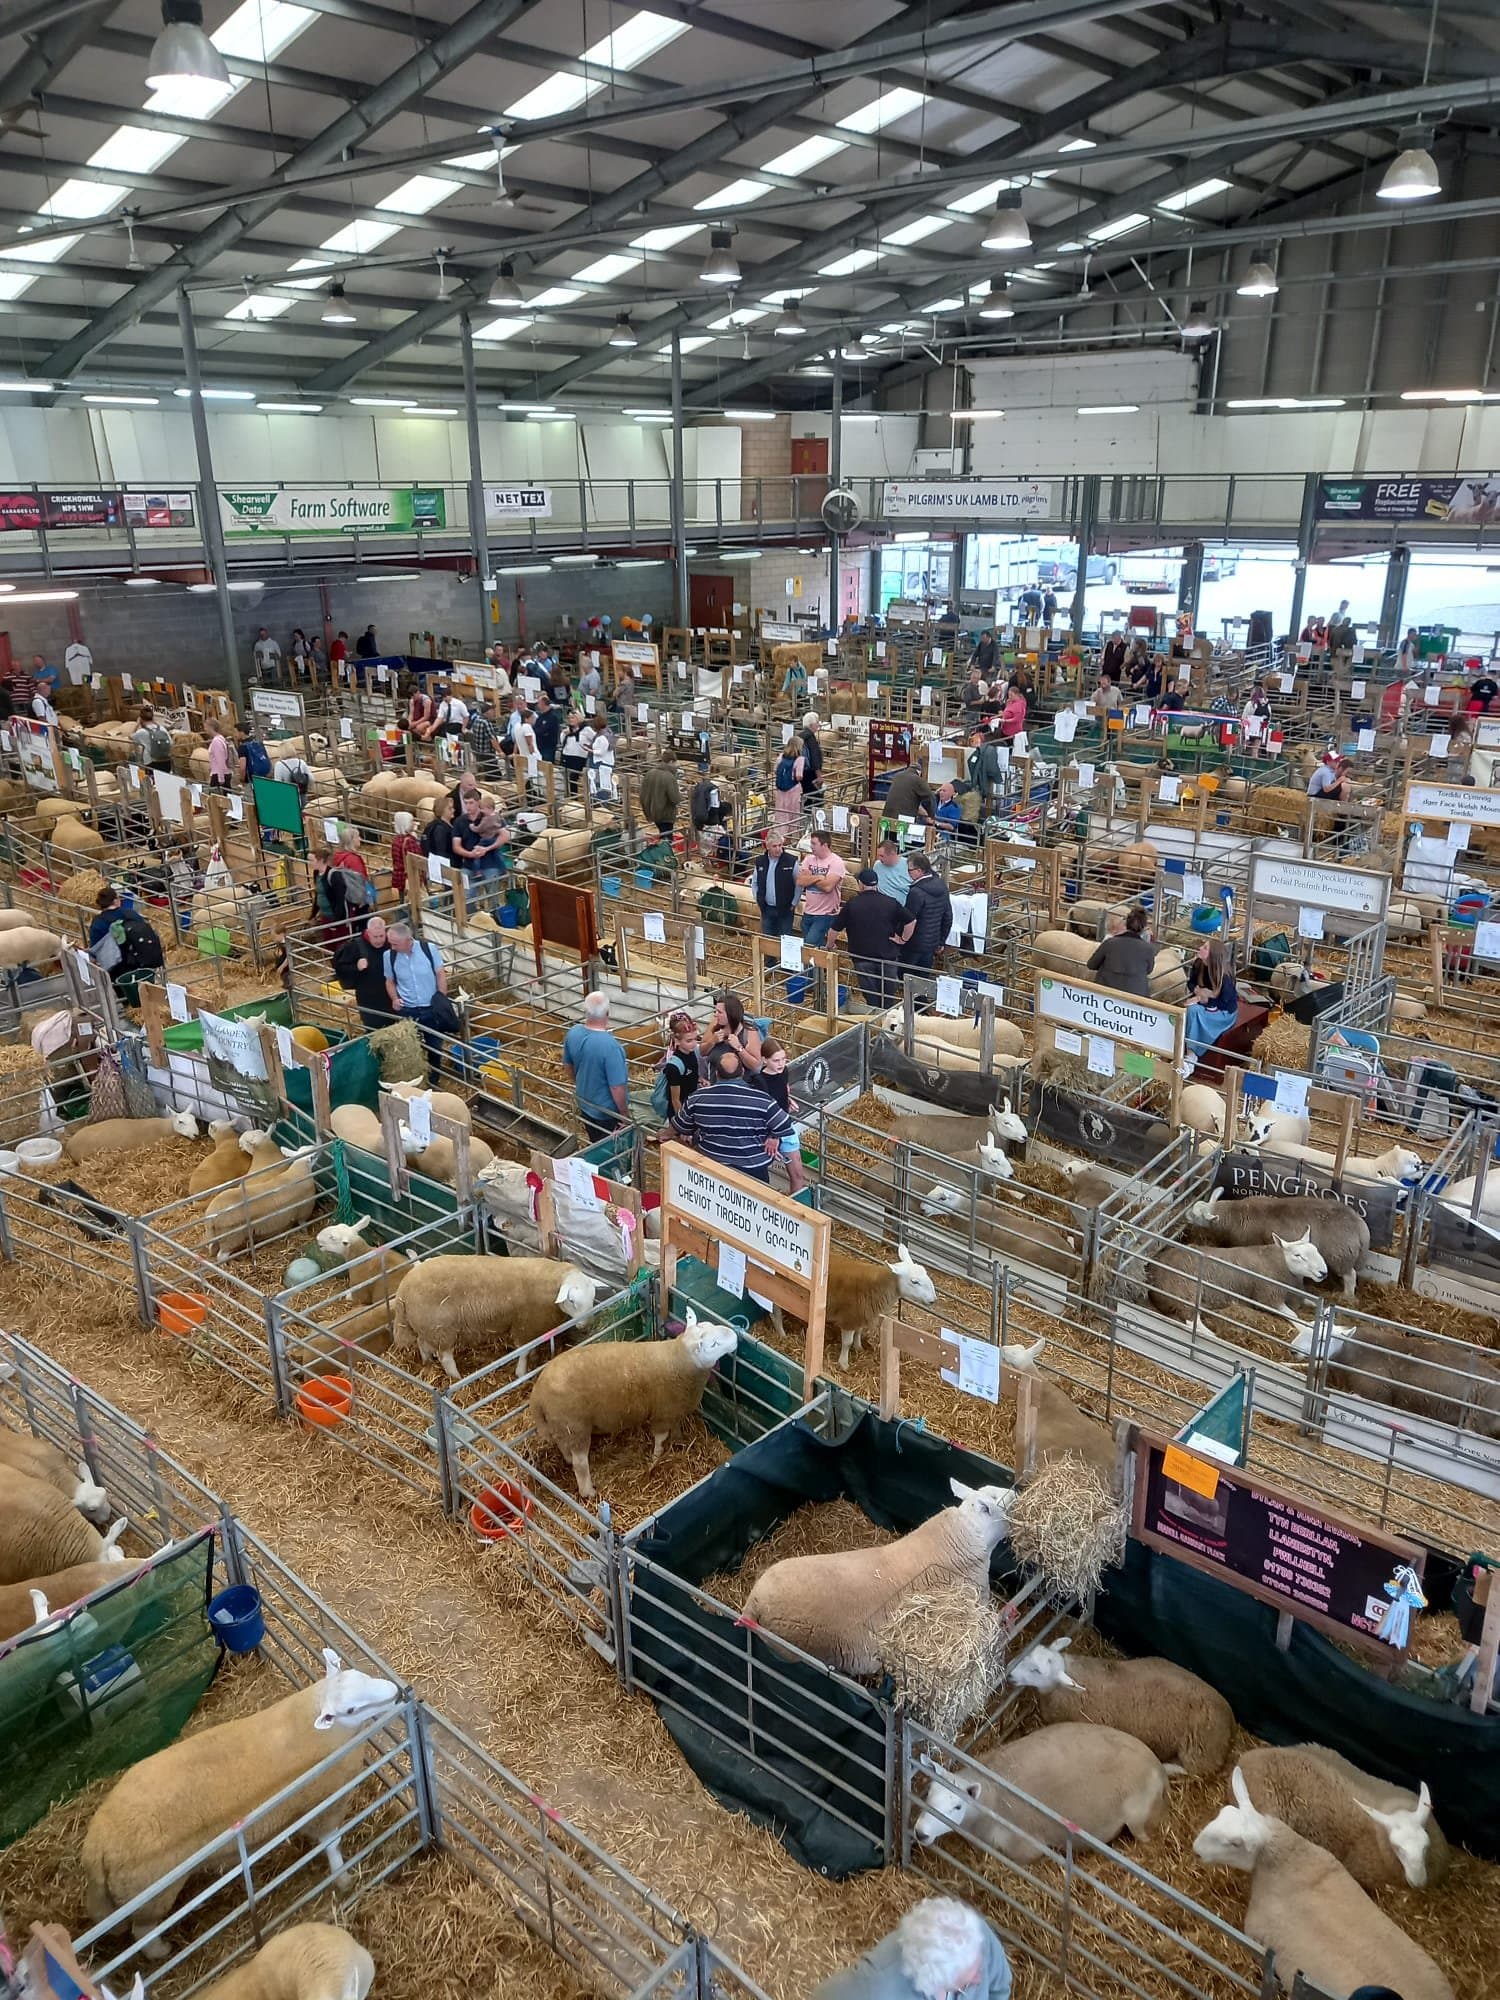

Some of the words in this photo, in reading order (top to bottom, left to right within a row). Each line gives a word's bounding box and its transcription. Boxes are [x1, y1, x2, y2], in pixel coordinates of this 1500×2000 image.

[51, 495, 103, 503] CRICKHOWELL
[231, 494, 271, 504] Shearwell
[1376, 483, 1422, 498] FREE
[290, 498, 326, 518] Farm
[330, 497, 390, 518] Software
[908, 494, 953, 506] PILGRIM'S
[955, 494, 969, 506] UK
[970, 494, 998, 506] LAMB
[242, 505, 263, 514] Data
[1282, 865, 1302, 876] Welsh
[1303, 869, 1316, 878] Hill
[1062, 986, 1099, 1009] North
[1102, 999, 1158, 1027] Country
[1082, 1010, 1134, 1036] Cheviot
[1232, 1167, 1369, 1218] PENGROES
[678, 1184, 712, 1212] CHEVIOT
[715, 1202, 752, 1233] TIROEDD
[755, 1223, 762, 1238] Y
[687, 1169, 715, 1193] NORTH
[718, 1184, 759, 1215] COUNTRY
[762, 1207, 800, 1237] CHEVIOT
